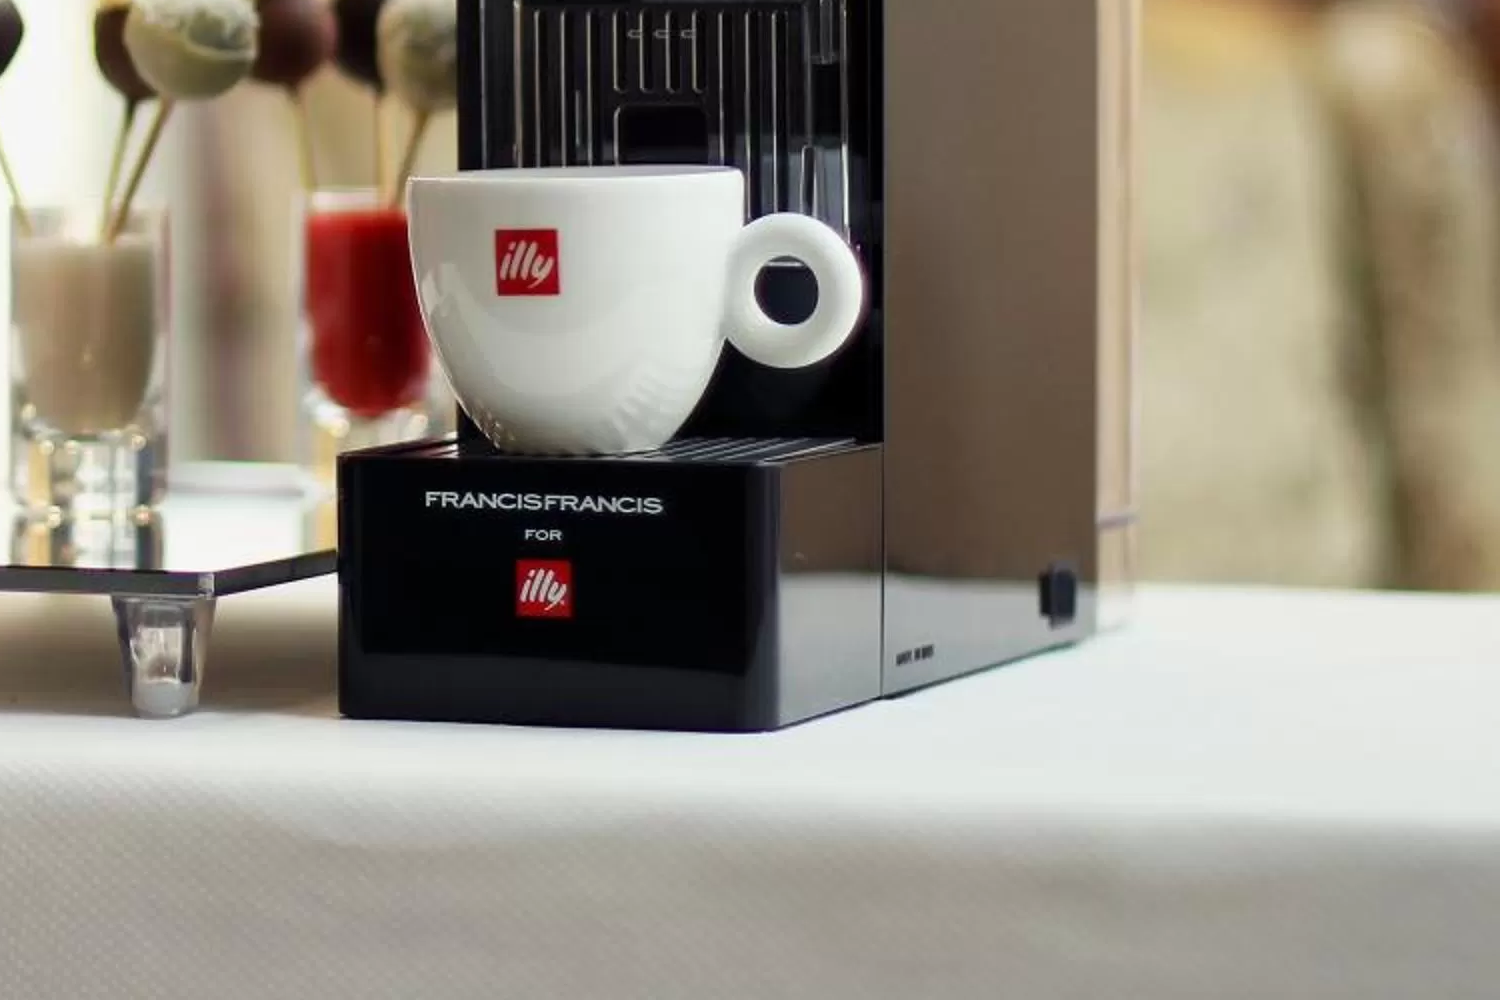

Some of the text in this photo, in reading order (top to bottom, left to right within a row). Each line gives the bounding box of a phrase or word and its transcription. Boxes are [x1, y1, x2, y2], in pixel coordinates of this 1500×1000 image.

[499, 239, 555, 289] illy
[524, 528, 563, 541] FOR
[520, 567, 568, 611] illy
